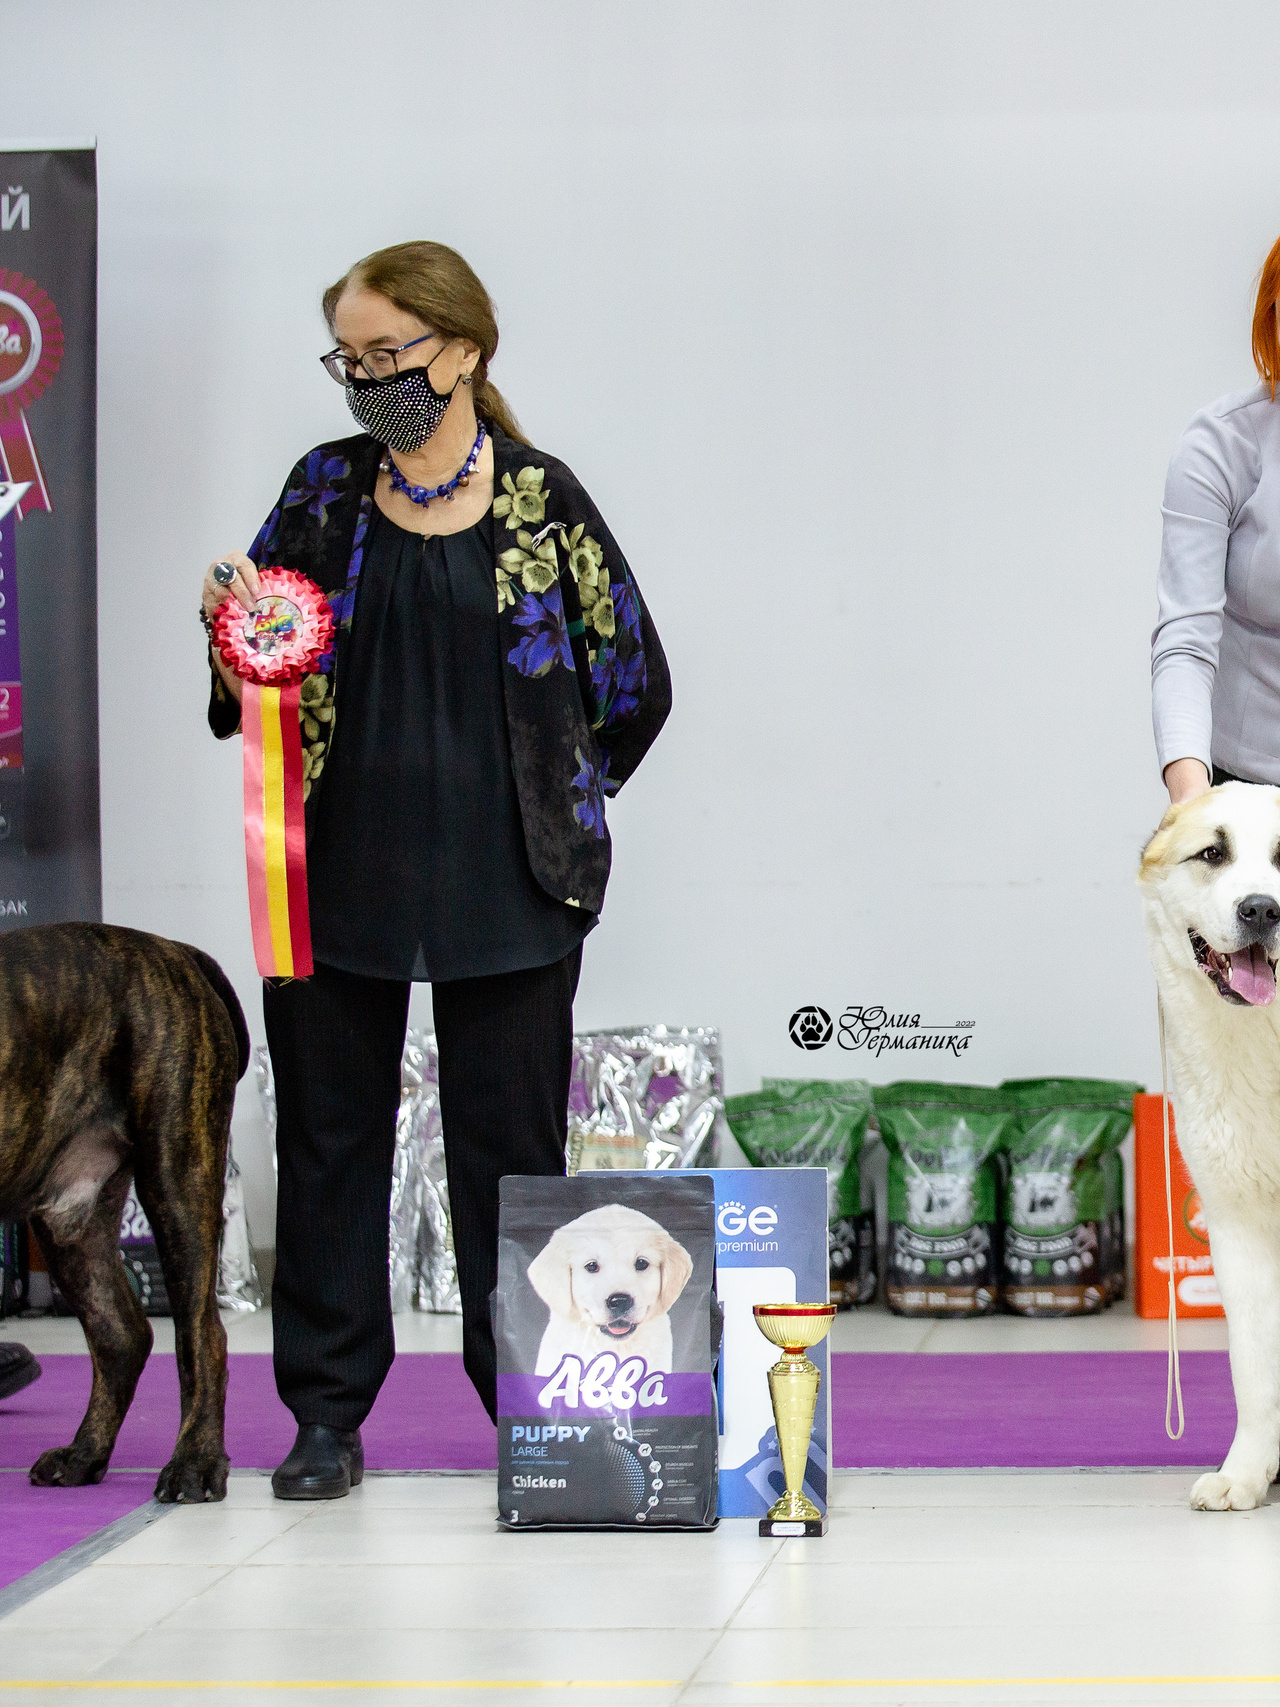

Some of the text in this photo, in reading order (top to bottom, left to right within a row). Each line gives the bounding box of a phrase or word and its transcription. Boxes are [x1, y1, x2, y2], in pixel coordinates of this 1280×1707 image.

[255, 614, 293, 632] BIG
[512, 1425, 591, 1443] PUPPY
[511, 1446, 548, 1457] LARGE
[512, 1475, 567, 1488] Chicken
[510, 1509, 519, 1523] 3
